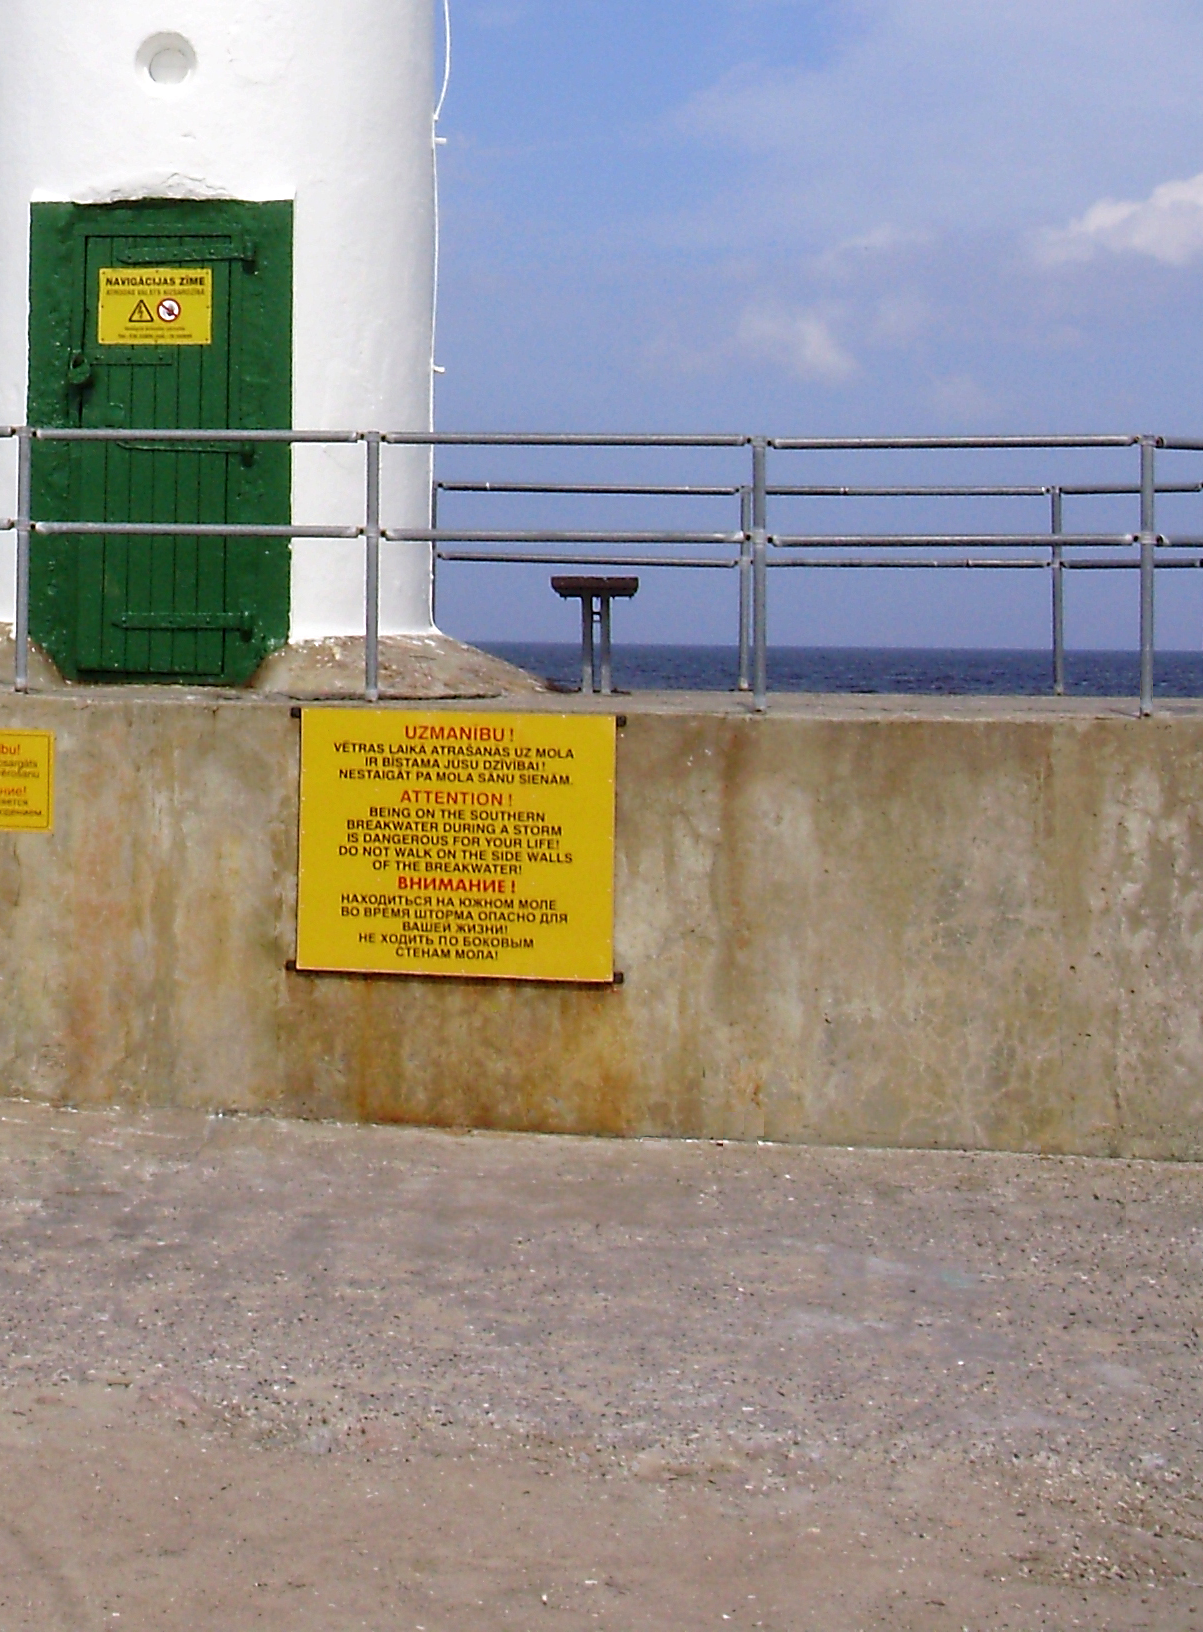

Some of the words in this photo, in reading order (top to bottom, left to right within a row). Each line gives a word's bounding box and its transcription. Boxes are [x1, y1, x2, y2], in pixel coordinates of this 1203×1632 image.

[105, 275, 176, 286] NAVIGĀCIJAS
[179, 274, 205, 286] ZĪME
[404, 724, 504, 742] UZMANĪBU
[333, 740, 384, 754] VĒTRAS
[514, 748, 532, 758] UZ
[536, 748, 574, 759] MOLA
[365, 756, 378, 767] IR
[339, 767, 411, 780] NESTAIGĀT
[416, 771, 432, 781] PA
[436, 771, 474, 782] MOLA
[400, 789, 503, 806] ATTENTION
[369, 806, 411, 818] BEING
[415, 808, 435, 819] ON
[440, 809, 465, 820] THE
[470, 810, 545, 822] SOUTHERN
[347, 819, 438, 832] BREAKWATER
[443, 821, 496, 834] DURING
[500, 824, 509, 834] A
[513, 825, 562, 836] STORM
[347, 832, 358, 843] IS
[363, 833, 448, 846] DANGEROUS
[453, 835, 480, 847] FOR
[485, 836, 522, 848] YOUR
[527, 838, 560, 850] LIFE!
[339, 845, 358, 856] DO
[363, 846, 389, 857] NOT
[394, 847, 432, 858] WALK
[437, 848, 456, 859] ON
[461, 849, 487, 861] THE
[491, 850, 522, 862] SIDE
[527, 851, 573, 864] WALLS
[372, 859, 390, 871] OF
[395, 860, 420, 872] THE
[425, 861, 522, 875] BREAKWATER!
[398, 876, 506, 894] ВНИМАНИЕ
[341, 893, 432, 907] НАХОДИТЬСЯ
[437, 896, 455, 907] НА
[459, 898, 514, 909] ЮЖНОМ
[518, 899, 556, 911] МОЛЕ
[341, 906, 360, 917] ВО
[364, 907, 410, 919] ВРЕМЯ
[415, 909, 474, 921] ШТОРМА
[478, 911, 536, 923] ОПАСНО
[540, 913, 568, 925] ДЛЯ
[456, 924, 508, 935] ЖИЗНИ!
[359, 933, 375, 944] НЕ
[381, 934, 434, 946] ХОДИТЬ
[438, 936, 458, 947] ПО
[463, 937, 534, 949] БОКОВЫМ
[395, 947, 451, 959] СТЕНАМ
[455, 949, 498, 961] МОЛА!
